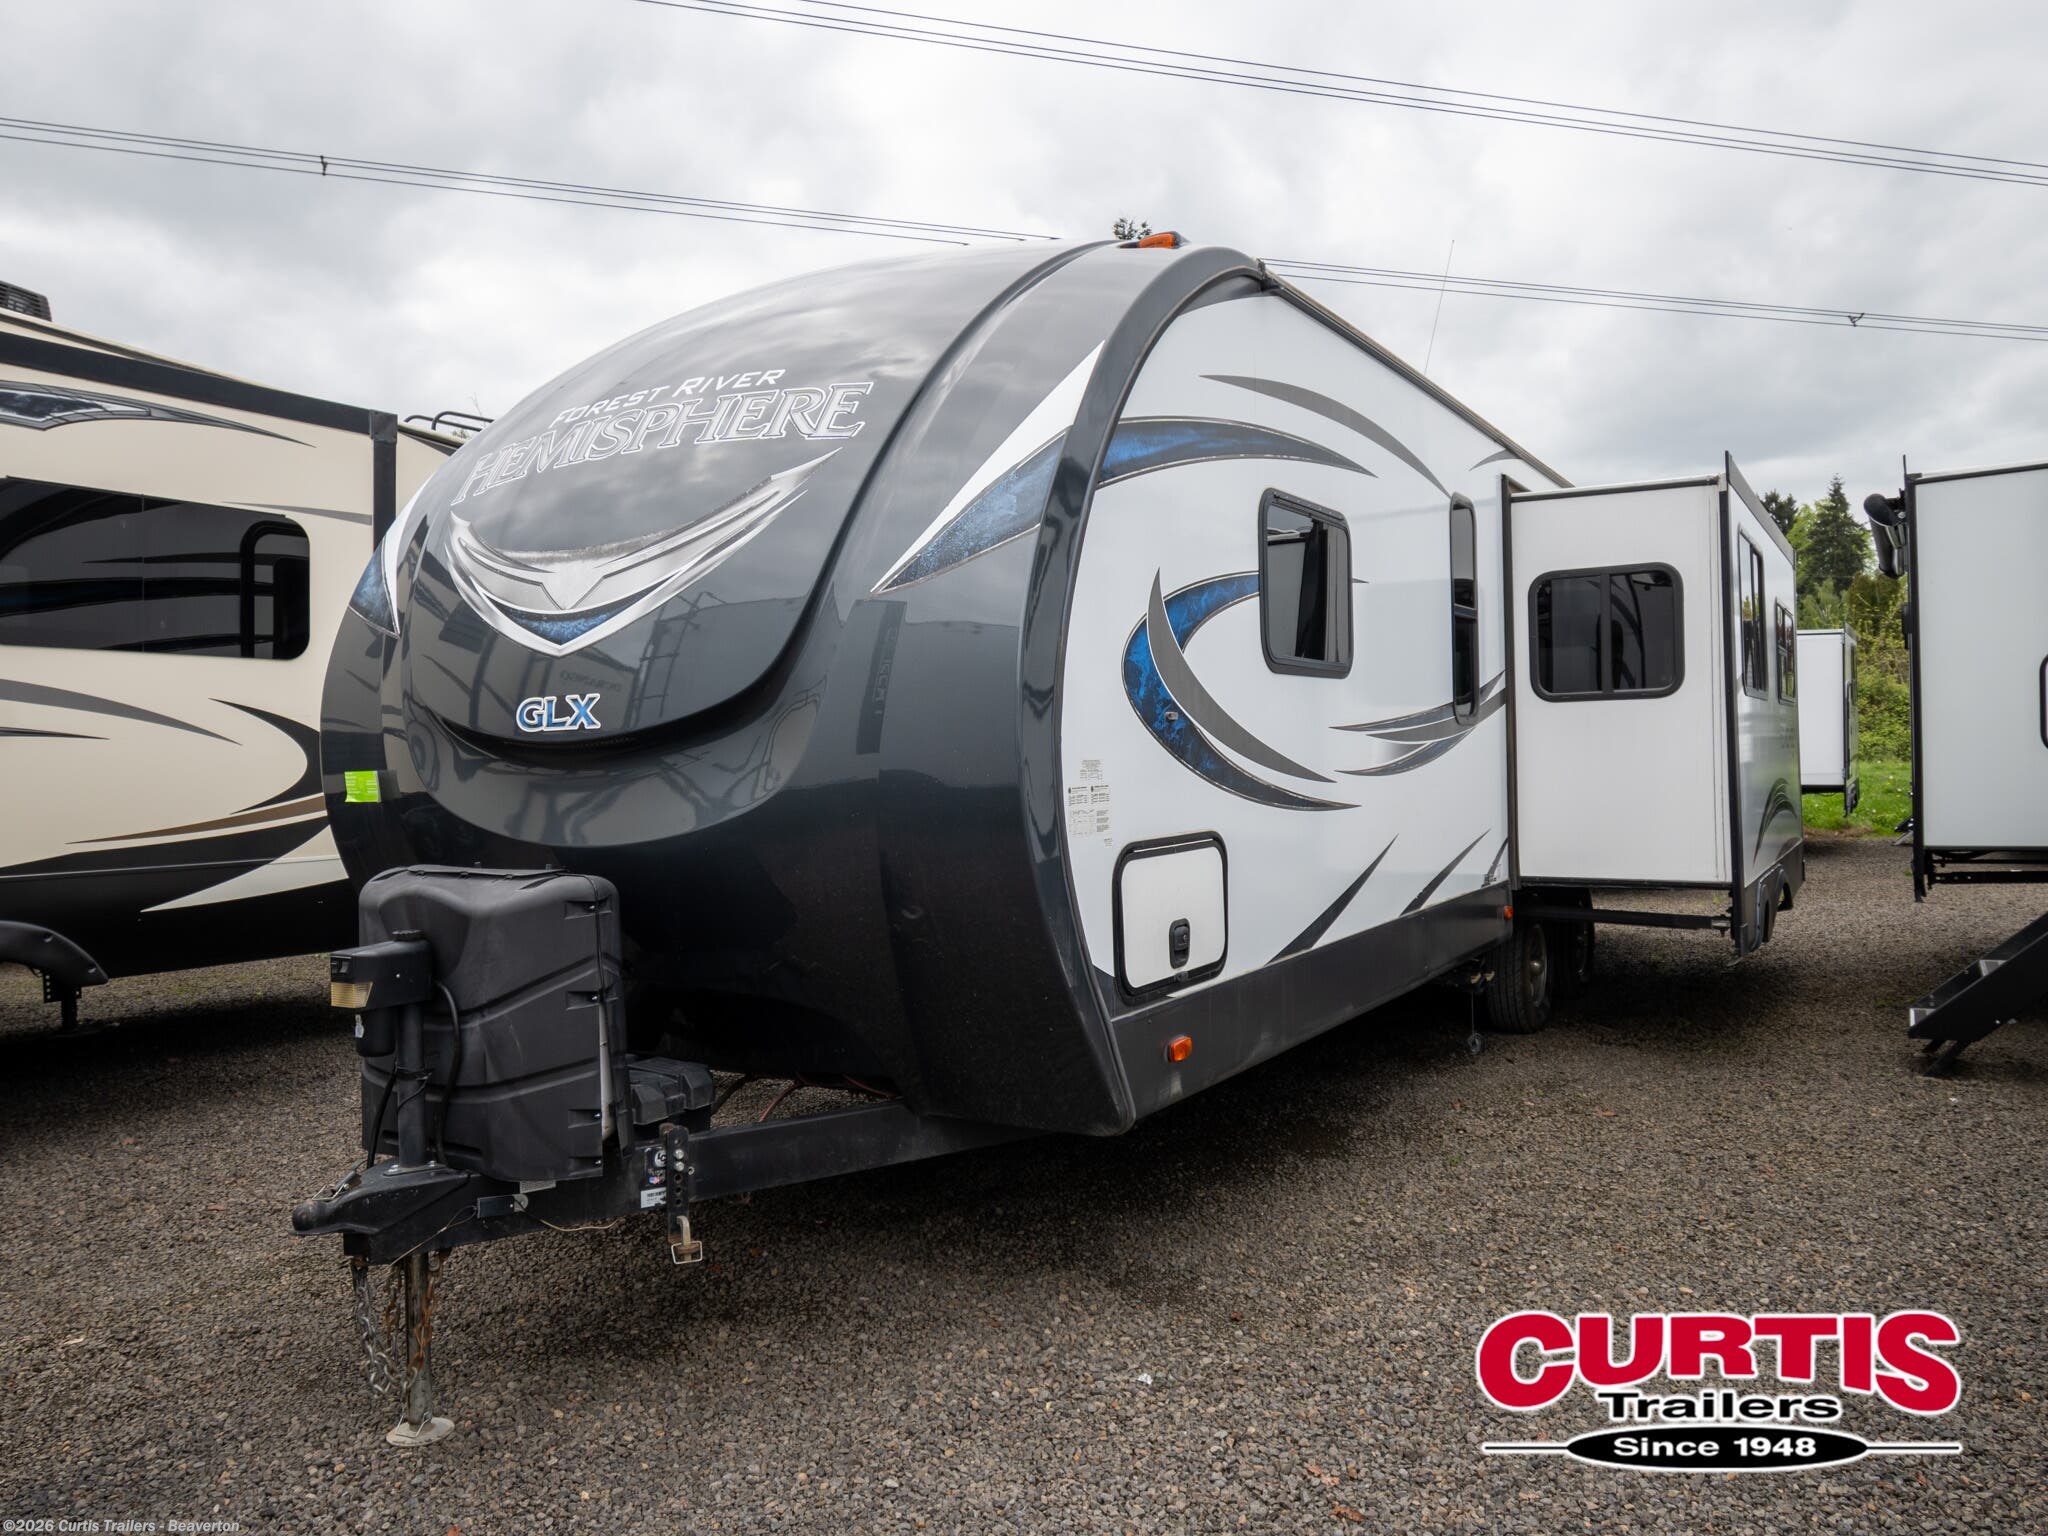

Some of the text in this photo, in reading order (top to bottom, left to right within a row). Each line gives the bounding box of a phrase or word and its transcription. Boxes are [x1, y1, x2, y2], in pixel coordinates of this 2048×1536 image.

[549, 369, 786, 428] FOREST RIVER
[452, 381, 874, 506] HEMISPHERE
[516, 693, 602, 732] GLX
